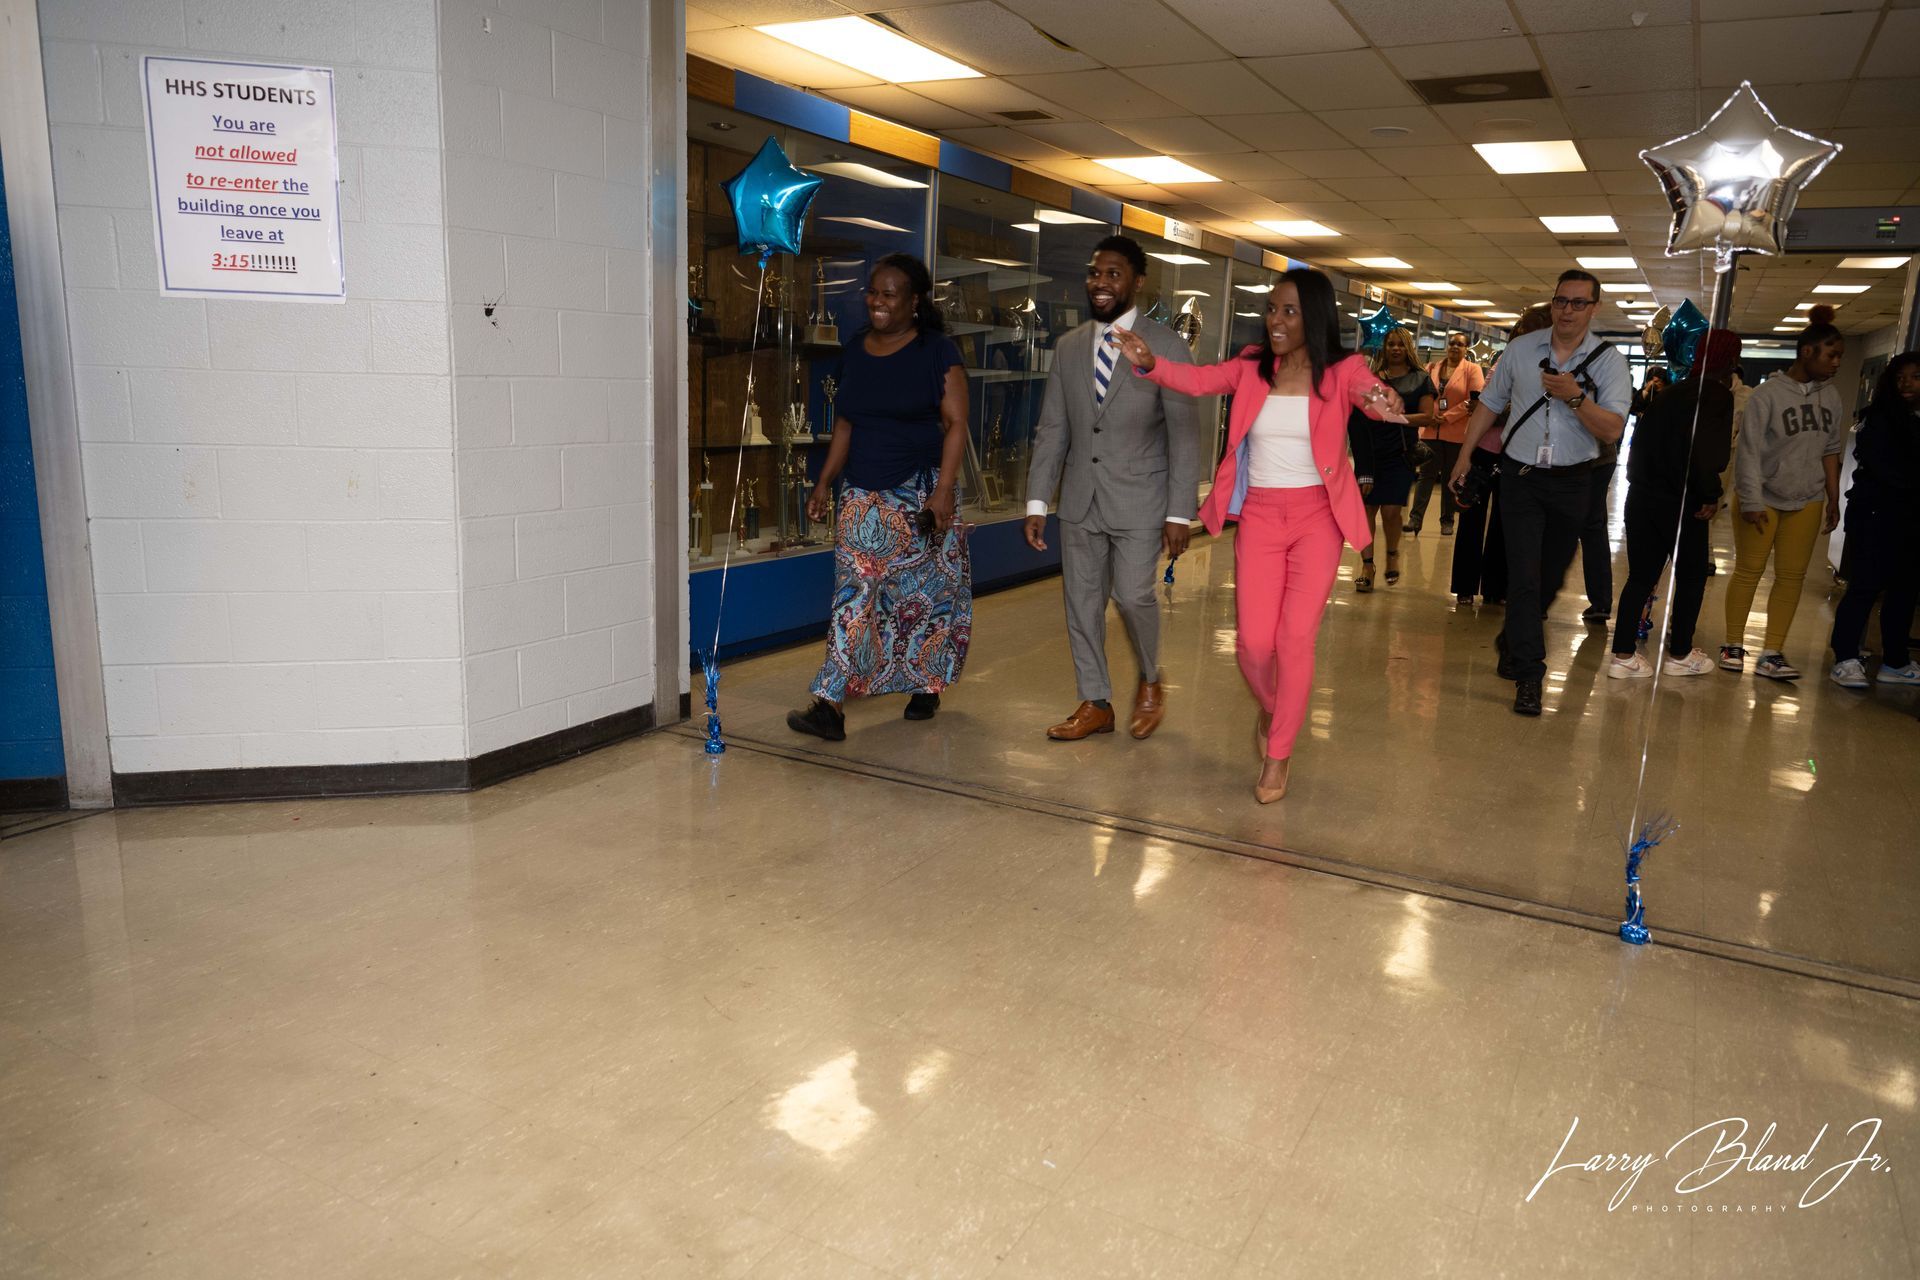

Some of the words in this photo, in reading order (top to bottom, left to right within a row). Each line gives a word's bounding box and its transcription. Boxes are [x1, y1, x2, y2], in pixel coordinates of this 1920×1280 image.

[165, 78, 207, 97] HHS
[213, 82, 317, 106] STUDENTS
[212, 115, 244, 130] You
[249, 120, 276, 132] are
[195, 145, 224, 158] not
[229, 145, 297, 163] allowed
[186, 172, 204, 186] to
[209, 176, 279, 191] re-enter
[282, 178, 309, 192] the
[177, 197, 245, 216] building
[249, 204, 287, 216] once
[291, 206, 320, 219] you
[220, 225, 263, 240] leave
[268, 229, 284, 241] at
[1782, 404, 1833, 437] GAP
